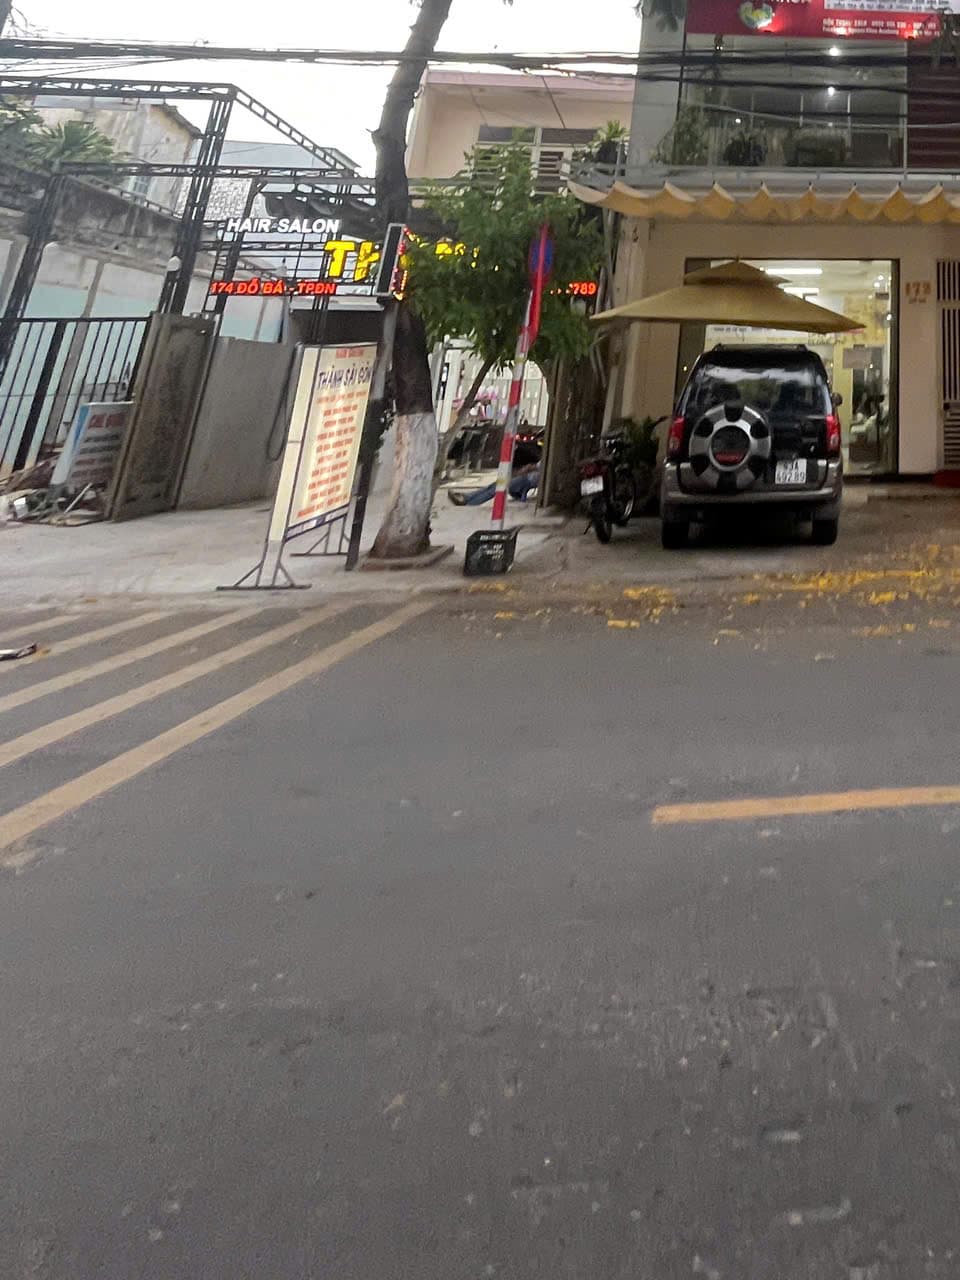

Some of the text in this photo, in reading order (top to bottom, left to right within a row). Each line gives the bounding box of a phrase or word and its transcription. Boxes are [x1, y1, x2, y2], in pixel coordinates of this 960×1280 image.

[226, 218, 340, 233] HAIR SALON
[210, 282, 232, 294] 174
